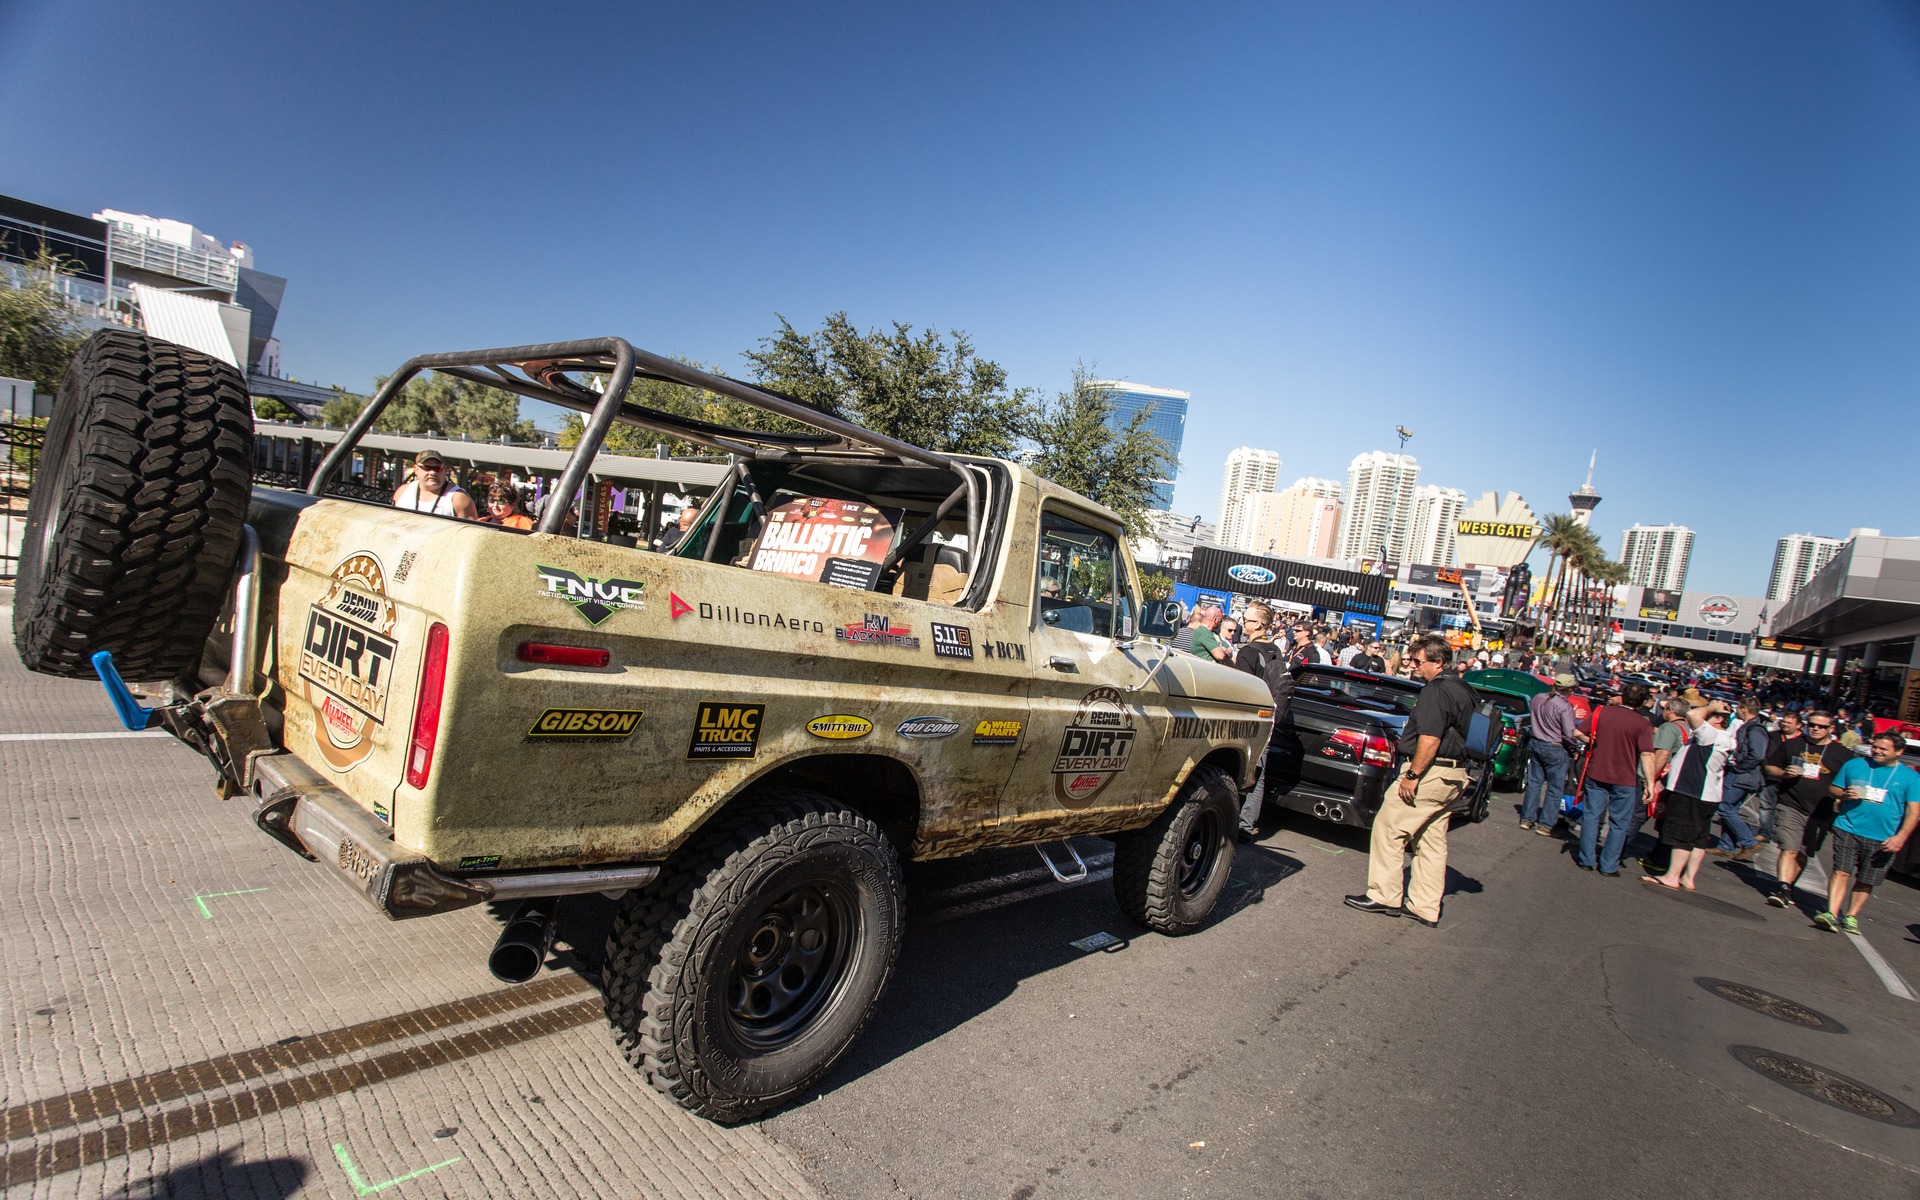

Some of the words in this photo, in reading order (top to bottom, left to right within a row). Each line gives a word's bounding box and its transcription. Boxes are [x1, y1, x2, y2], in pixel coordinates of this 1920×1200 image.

[772, 512, 787, 521] THE
[1458, 521, 1532, 538] WESTGATE
[760, 522, 872, 557] BALLISTIC
[753, 550, 818, 576] BRONCO
[1236, 568, 1266, 582] Ford
[539, 574, 644, 605] TNVC
[1287, 576, 1314, 589] OUT
[1314, 582, 1359, 597] FRONT
[537, 590, 569, 600] TACTICAL
[571, 595, 592, 603] NIGHT
[593, 598, 617, 607] VISION
[617, 602, 645, 611] COMPANY
[699, 602, 823, 633] DillonAero
[863, 613, 889, 632] H&M
[934, 625, 958, 644] 5.11
[305, 610, 394, 687] DIRT
[936, 645, 972, 657] TACTICAL
[996, 641, 1026, 661] BCM
[301, 652, 351, 691] EVERY
[350, 676, 384, 714] DAY
[540, 711, 638, 732] GIBSON
[700, 708, 758, 729] LMC
[811, 722, 868, 733] SMITTYBILT
[896, 722, 922, 733] PRO
[924, 722, 960, 734] COMP
[975, 720, 991, 736] 4
[992, 721, 1021, 729] WHEEL
[1090, 711, 1121, 726] RECOIL
[1172, 716, 1226, 740] BALLISTIC
[1227, 720, 1260, 739] BRONCO
[521, 736, 589, 745] PERFORMANCE
[590, 736, 628, 745] EXHAUST
[699, 729, 754, 743] TRUCK
[990, 728, 1019, 736] PARTS
[1061, 730, 1134, 757] DIRT
[1056, 758, 1103, 770] EVERY
[1100, 757, 1127, 769] DAY
